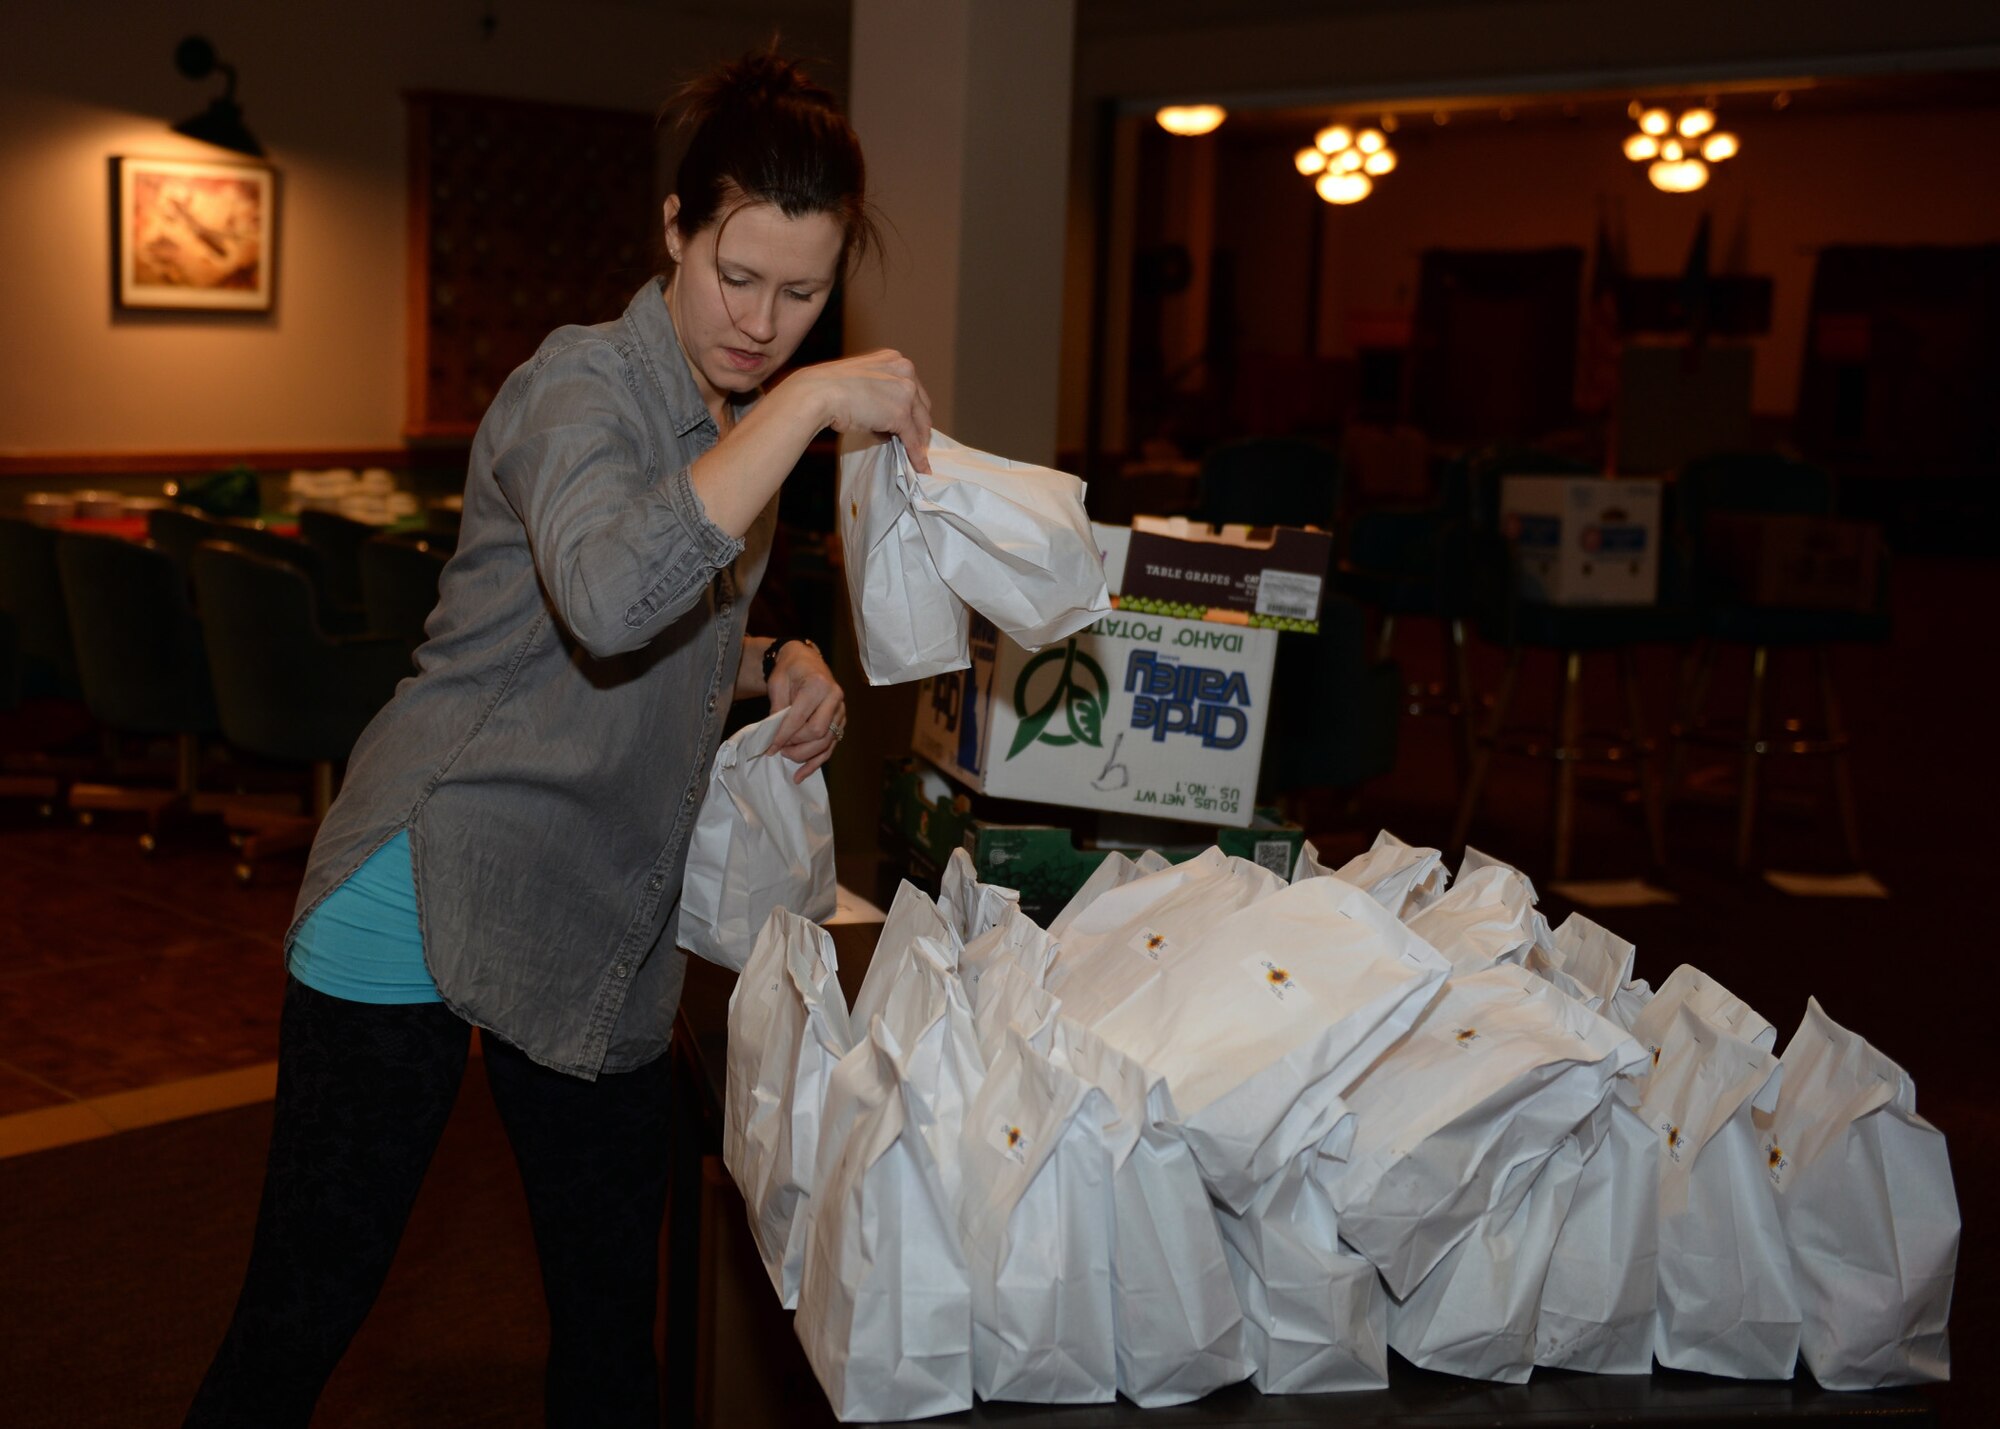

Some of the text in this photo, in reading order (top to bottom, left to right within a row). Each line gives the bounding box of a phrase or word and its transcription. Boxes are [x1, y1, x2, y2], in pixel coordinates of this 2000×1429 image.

[1145, 564, 1231, 586] TABLE GRAPES
[1130, 696, 1247, 750] Circle
[1134, 789, 1157, 804] WT
[1160, 793, 1186, 806] NET
[1219, 799, 1239, 814] 50
